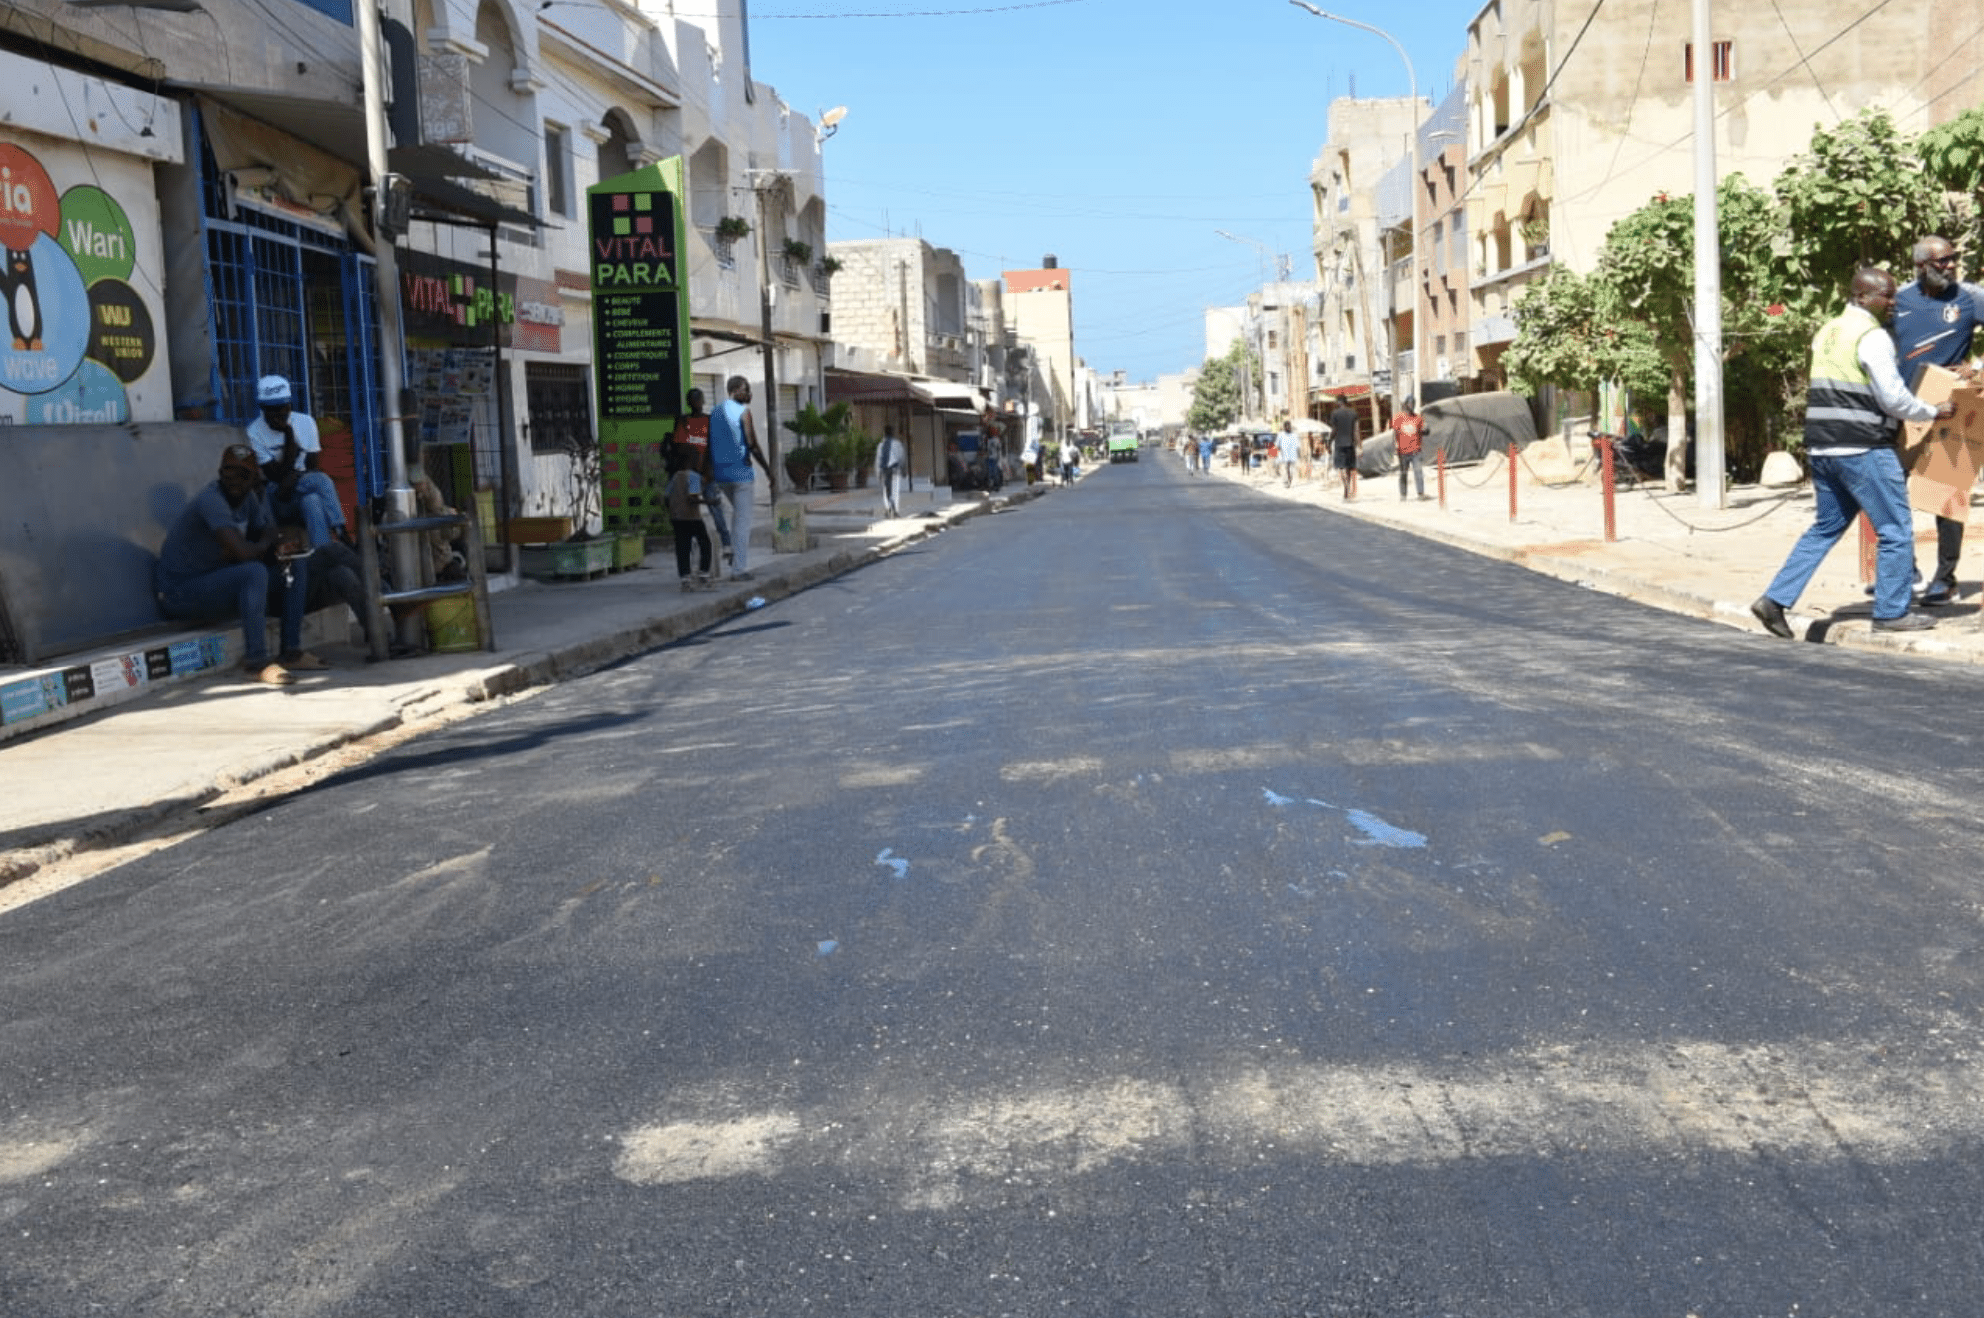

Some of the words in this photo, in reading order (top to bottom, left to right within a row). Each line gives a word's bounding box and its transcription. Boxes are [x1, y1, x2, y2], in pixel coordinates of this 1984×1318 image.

[0, 166, 33, 215] ia
[67, 219, 125, 260] Wari
[596, 236, 673, 259] VITAL
[405, 272, 454, 315] VITAL
[597, 262, 673, 285] PARA
